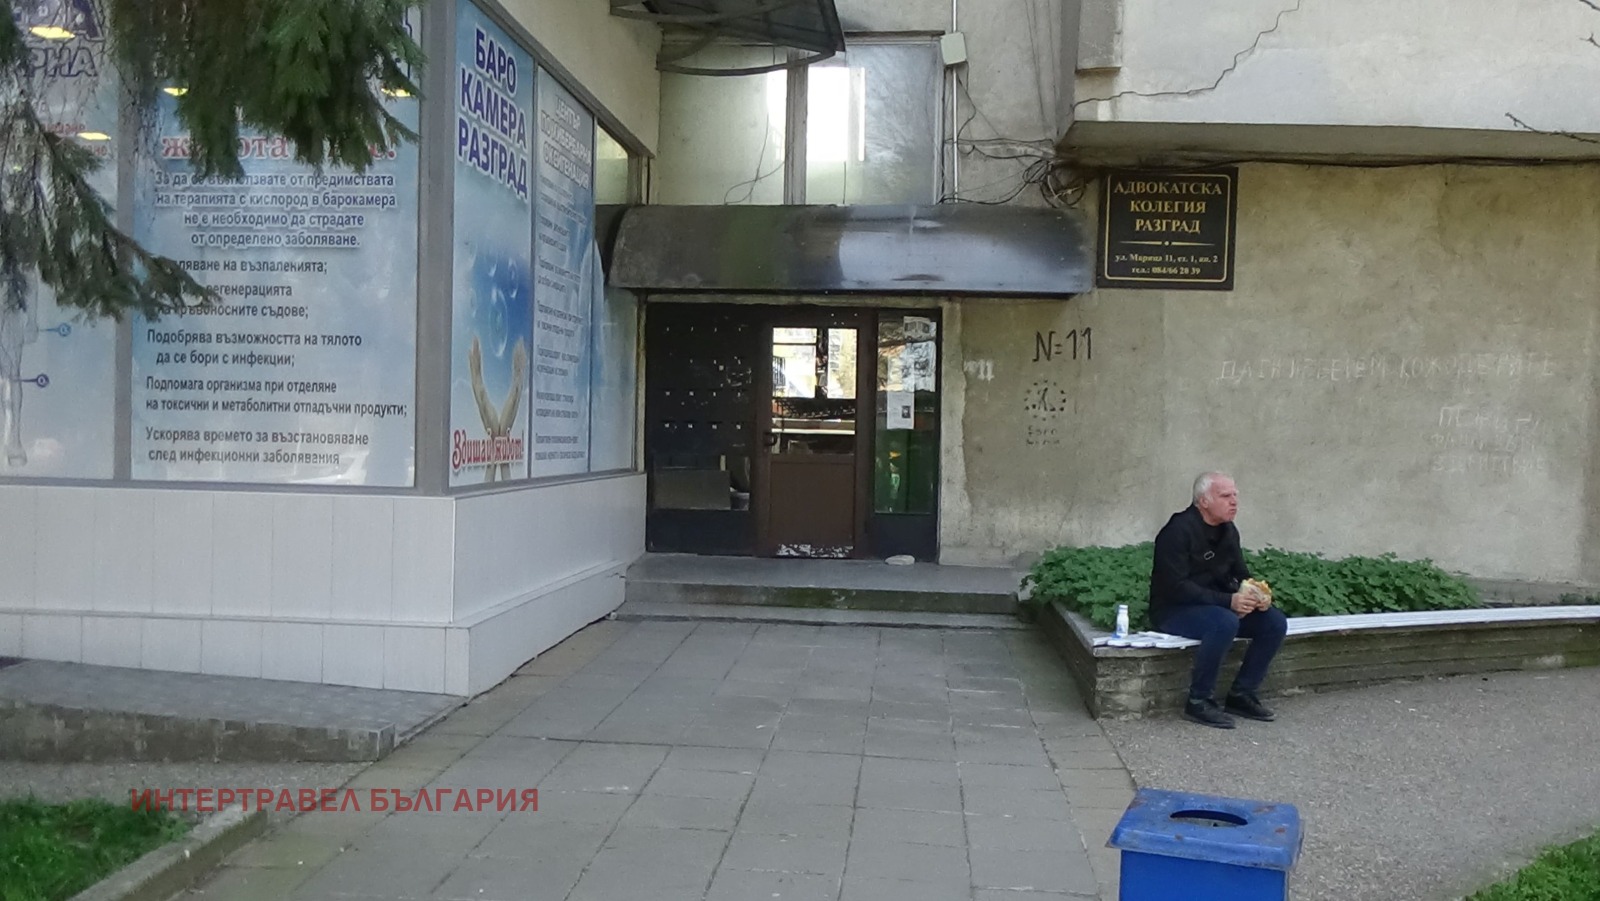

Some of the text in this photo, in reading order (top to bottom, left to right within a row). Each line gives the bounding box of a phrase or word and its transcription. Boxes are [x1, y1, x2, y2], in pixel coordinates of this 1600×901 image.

[476, 27, 516, 94] БАРО
[461, 67, 527, 149] КАМЕРА
[458, 117, 528, 200] РАЗГРАД
[173, 174, 187, 186] да
[290, 176, 304, 186] от
[307, 175, 394, 188] предимствата
[1114, 181, 1222, 195] АДВОКАТСКА
[157, 194, 170, 204] на
[174, 193, 235, 206] терапията
[250, 194, 308, 208] кислород
[312, 195, 319, 205] в
[322, 192, 396, 208] барокамера
[1130, 200, 1206, 214] КОЛЕГИЯ
[184, 211, 364, 228] не е необходимо да страдате
[1135, 219, 1201, 234] РАЗГРАД
[191, 232, 360, 248] от определено заболяване.
[178, 260, 327, 274] ляване на възпаленията;
[1115, 254, 1128, 263] ул.
[1212, 255, 1219, 264] 2
[261, 305, 309, 319] съдове;
[147, 328, 362, 346] Подобрява възможността на тялото
[156, 350, 295, 368] да се бори с инфекции;
[146, 376, 337, 395] Подпомага организма при отделяне
[146, 398, 407, 418] на токсични и метаболитни отпадъчни продукти;
[146, 426, 369, 445] Ускорява времето за възстановяване
[148, 448, 340, 464] след инфекционни заболявания
